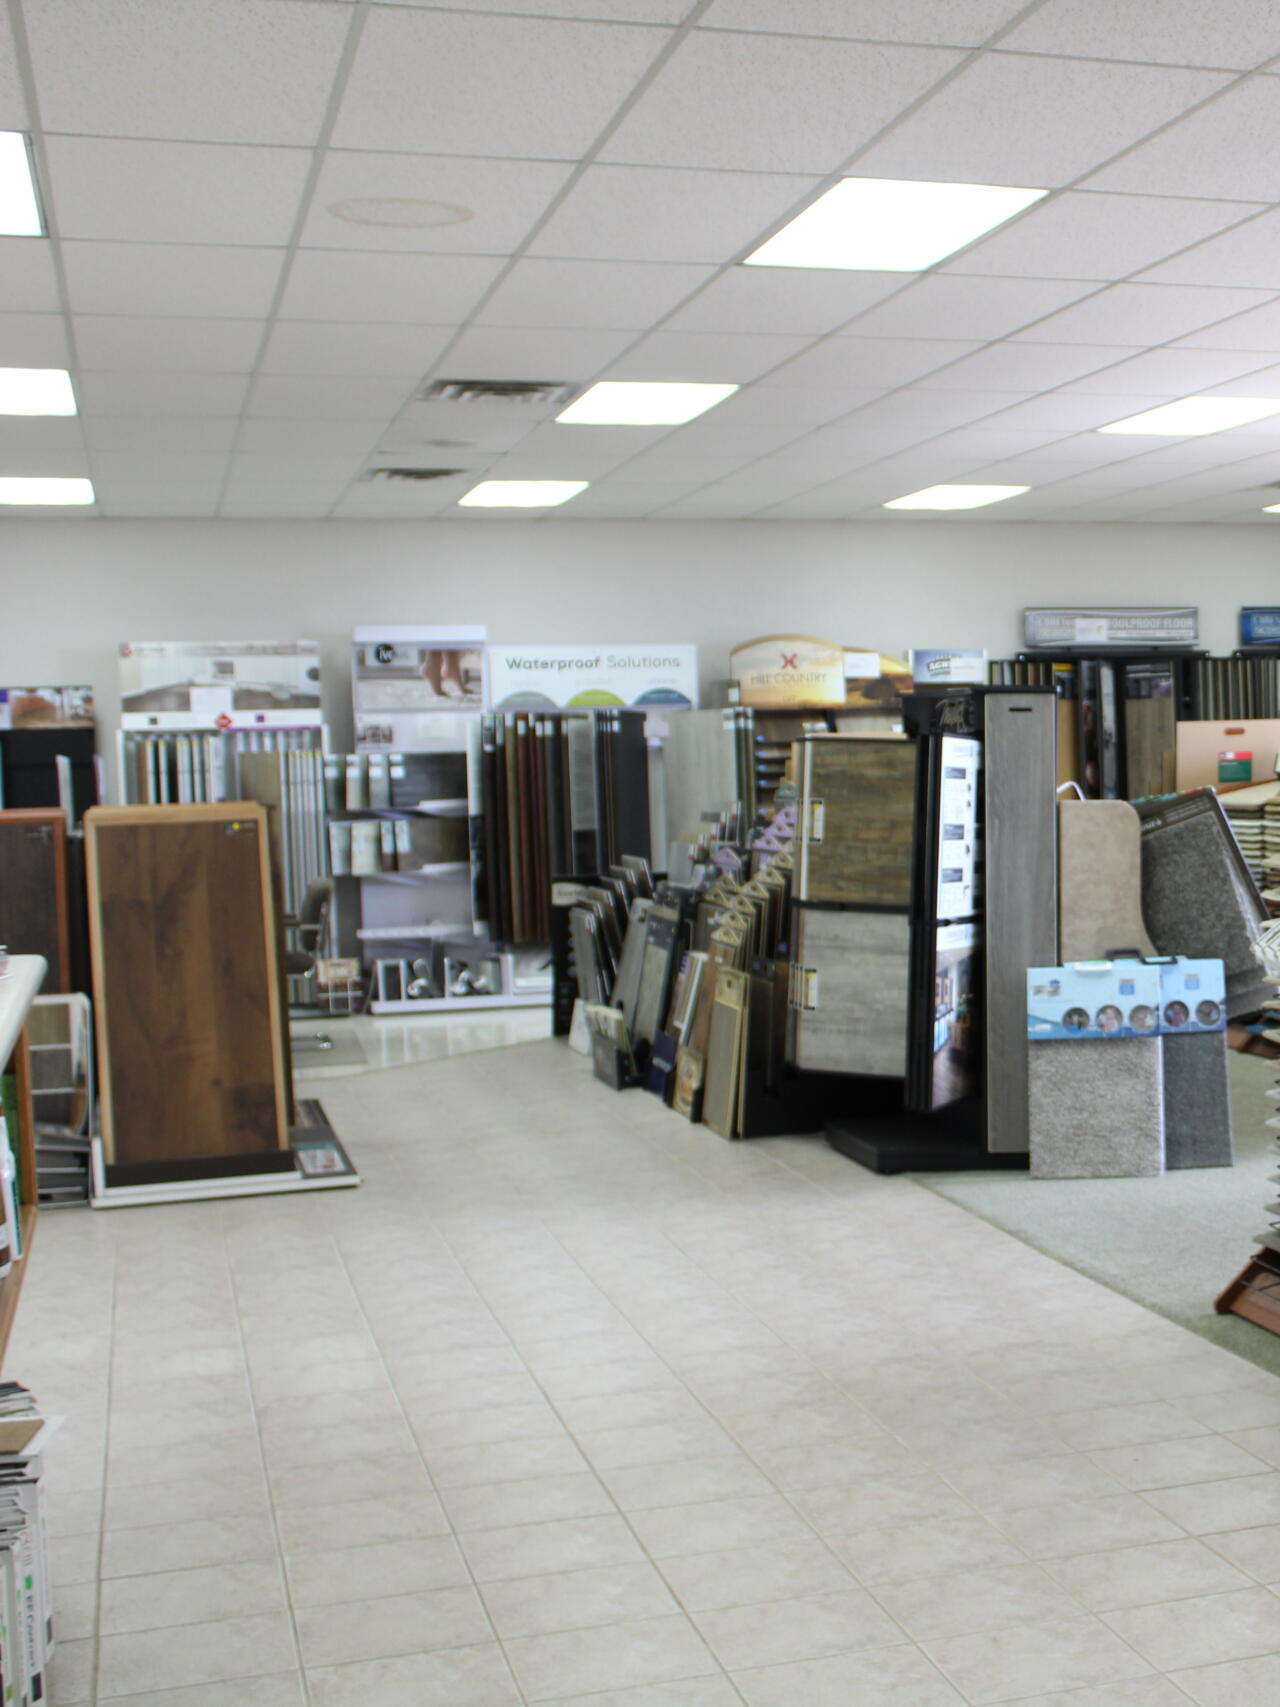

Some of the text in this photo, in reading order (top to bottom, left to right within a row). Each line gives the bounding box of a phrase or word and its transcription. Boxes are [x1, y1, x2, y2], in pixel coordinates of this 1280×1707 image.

[506, 655, 681, 671] Waterproof Solutions
[751, 672, 827, 685] HILL COUNTRY
